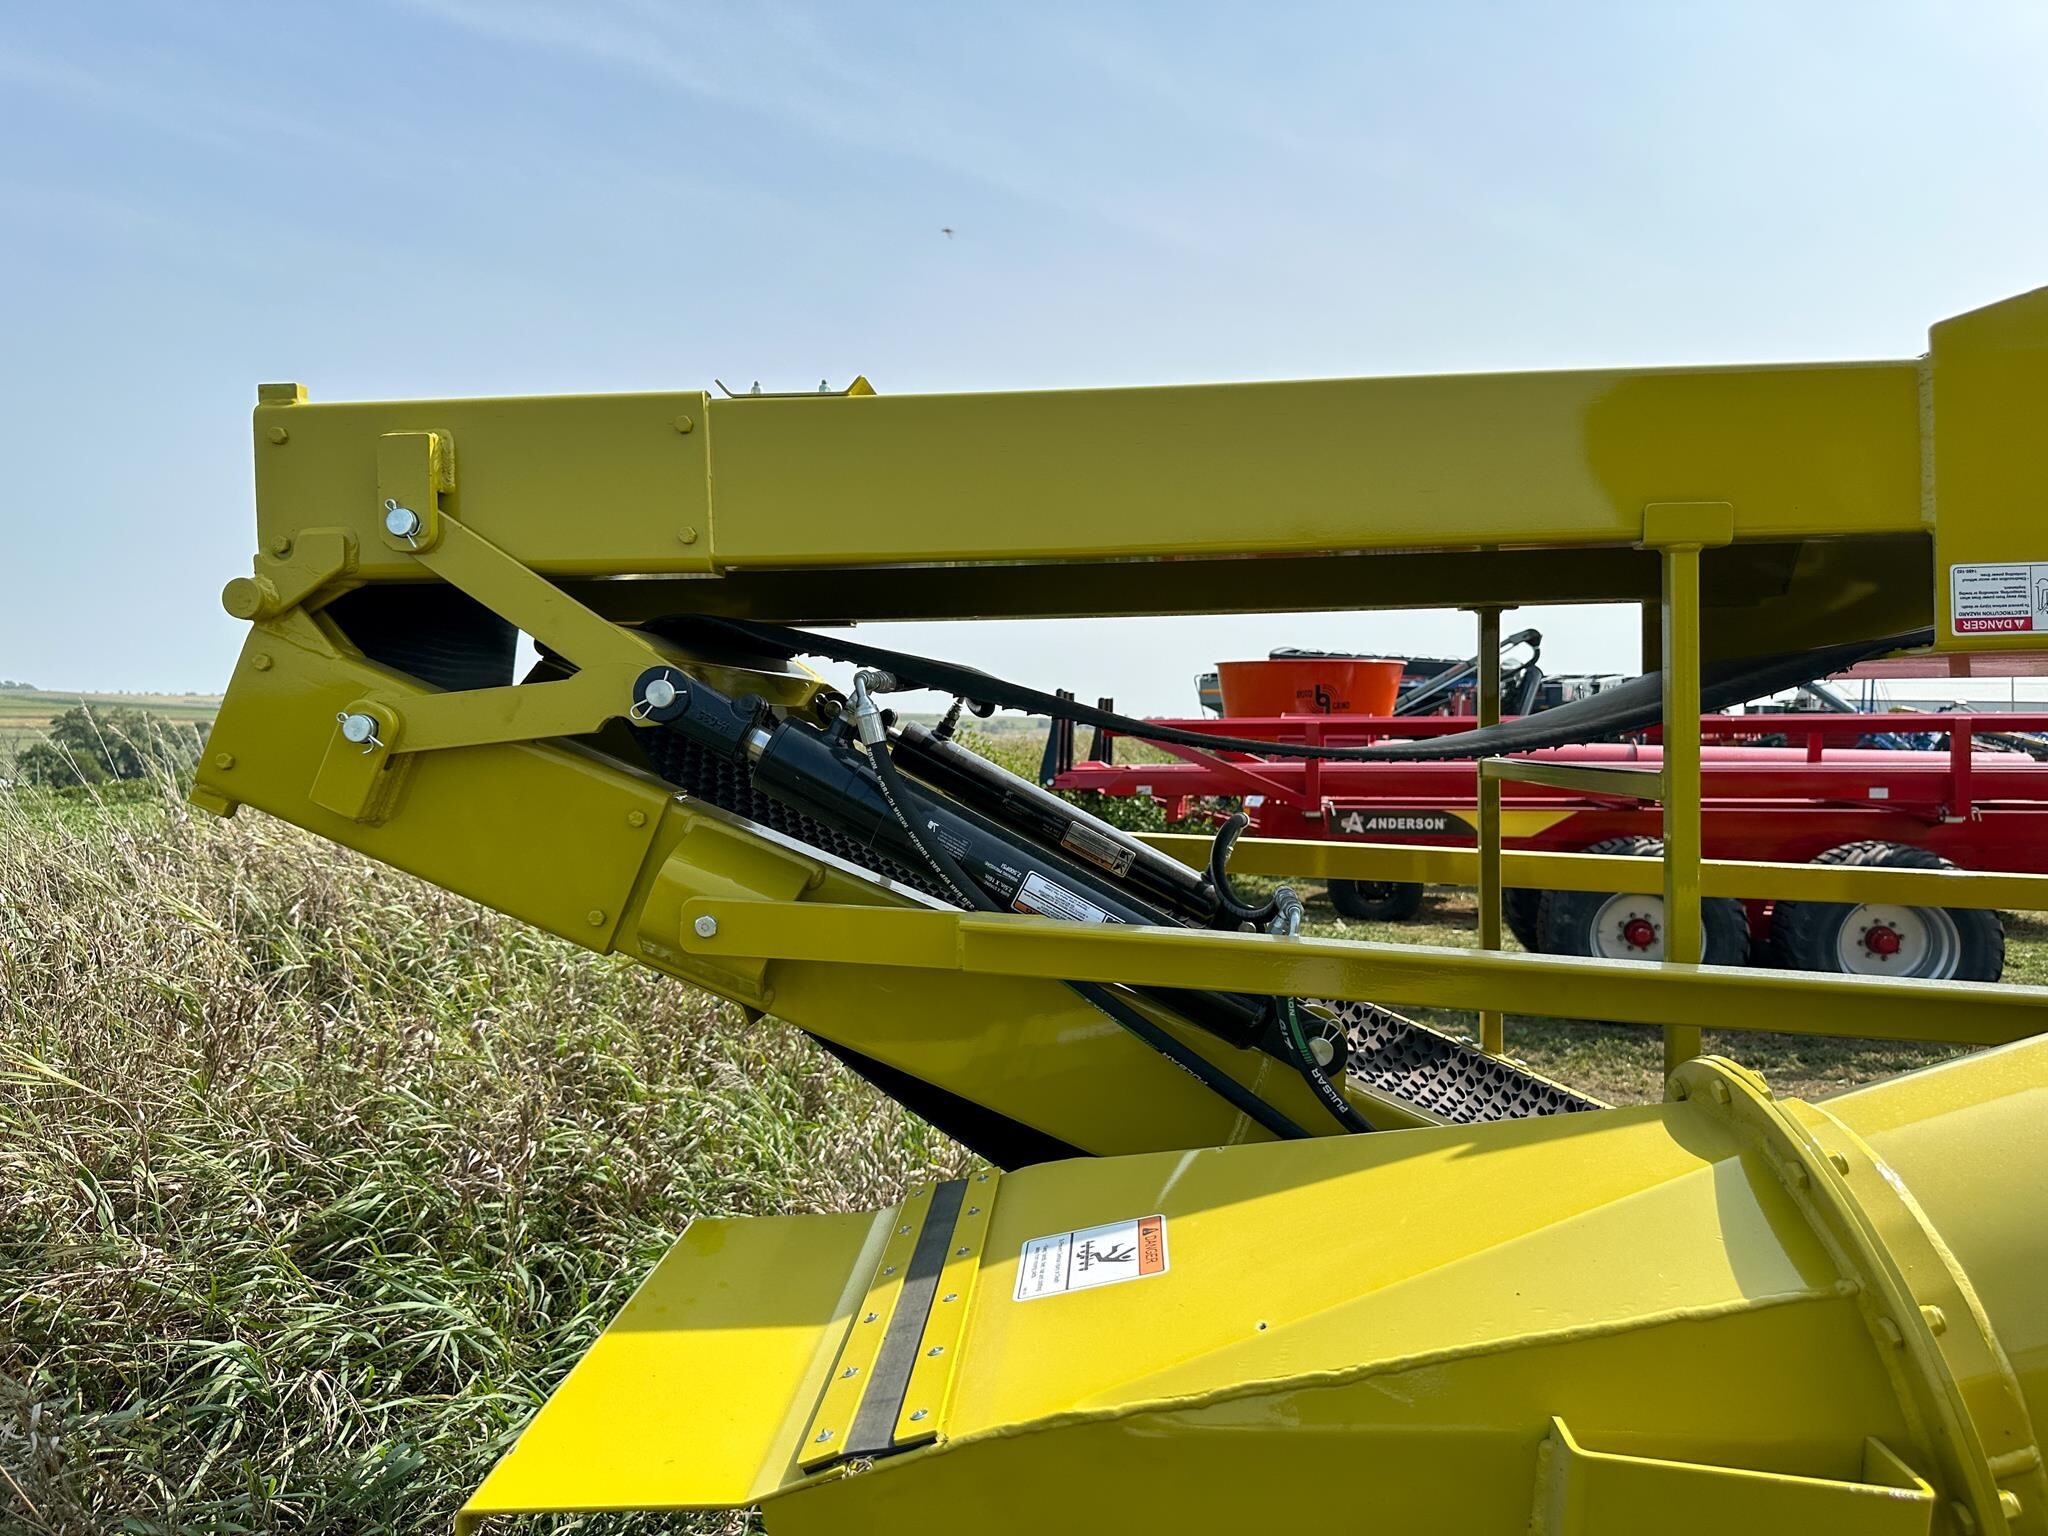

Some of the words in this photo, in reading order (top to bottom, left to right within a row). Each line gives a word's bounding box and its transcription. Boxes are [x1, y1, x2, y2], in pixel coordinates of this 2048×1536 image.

[1962, 619, 2012, 630] DANGER
[893, 806, 909, 829] MSHA
[1366, 817, 1444, 830] ANDERSON
[929, 859, 941, 873] SAE
[1311, 1067, 1348, 1114] PULSAR
[1144, 1234, 1159, 1265] DANGER
